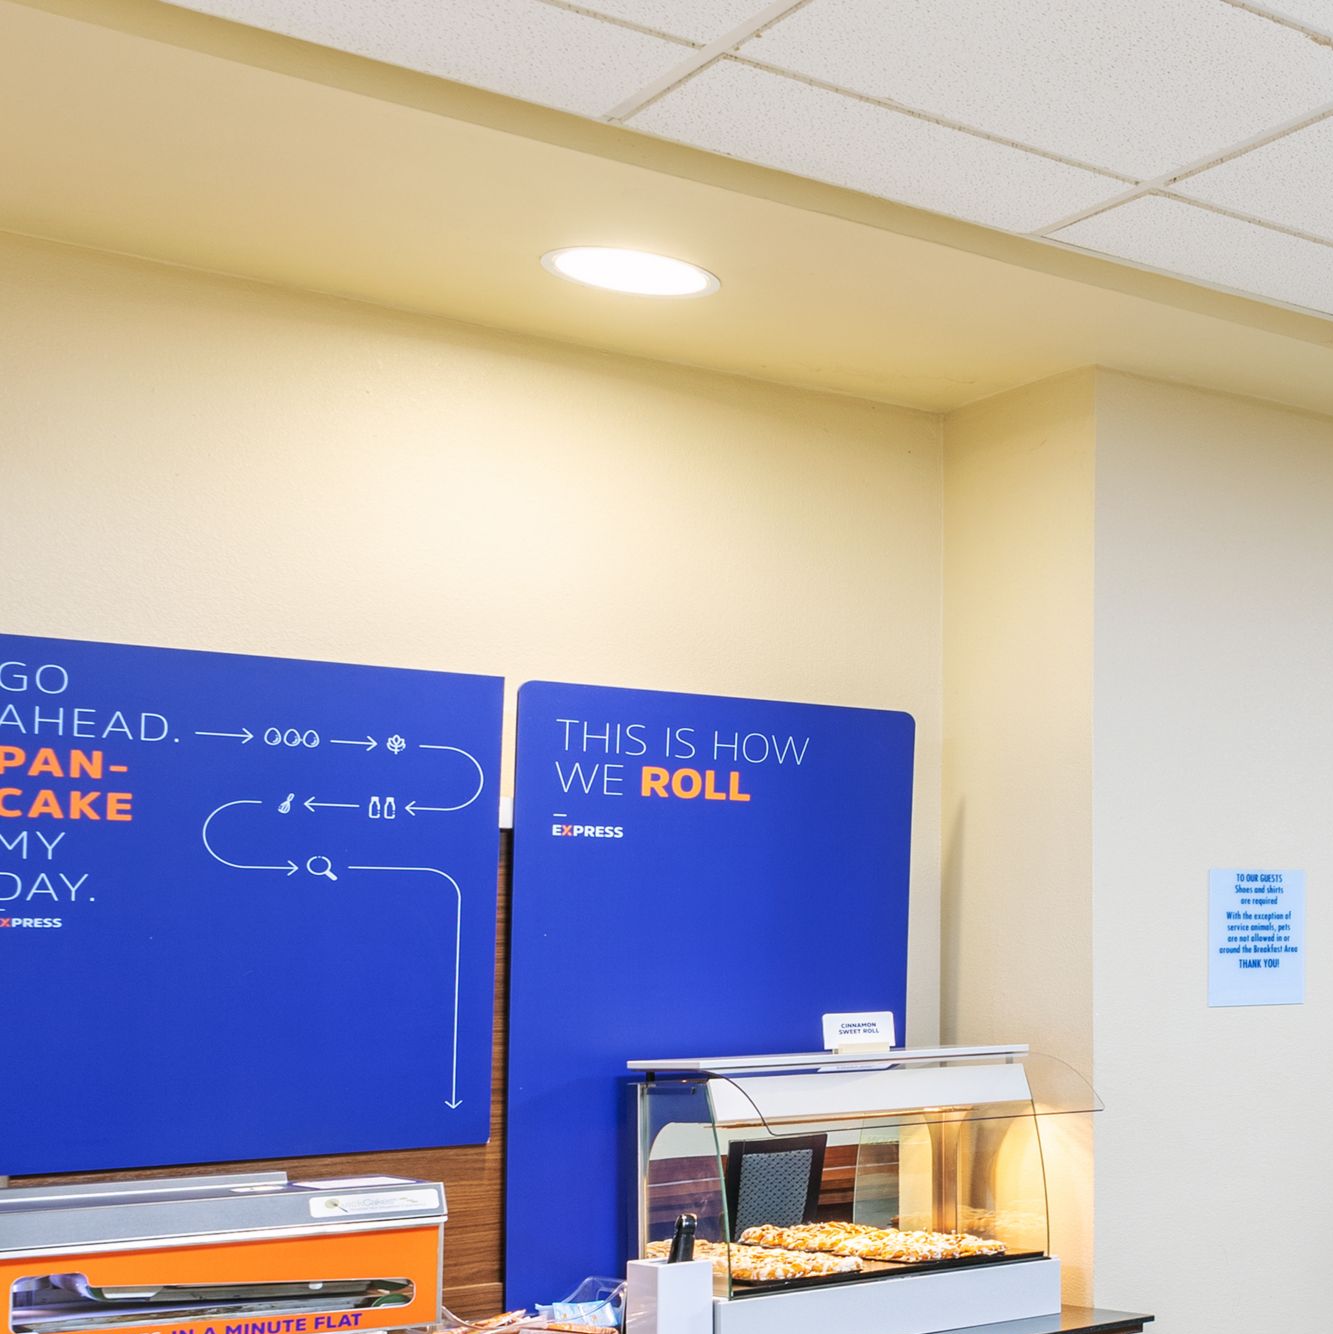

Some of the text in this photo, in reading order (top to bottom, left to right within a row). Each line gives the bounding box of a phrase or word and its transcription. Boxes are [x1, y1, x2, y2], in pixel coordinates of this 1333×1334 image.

[0, 660, 69, 694] GO
[0, 703, 181, 743] AHEAD.
[555, 718, 810, 766] THIS IS HOW
[0, 745, 129, 779] PAN-
[555, 761, 751, 802] WE ROLL
[0, 787, 134, 822] CAKE
[551, 823, 624, 839] EXPRESS
[1236, 873, 1283, 883] TO OUR GUESTS
[1235, 884, 1284, 893] Shoes and shirts
[1252, 896, 1278, 906] required
[1226, 910, 1292, 921] With the exception of
[1227, 923, 1249, 931] service
[1278, 923, 1291, 932] pets
[1240, 934, 1249, 942] not
[1251, 933, 1275, 942] allowed
[1276, 933, 1282, 942] in
[1219, 944, 1298, 954] around the Breakfast Area
[1239, 958, 1280, 969] THANK YOU!
[314, 1312, 363, 1330] FLAT
